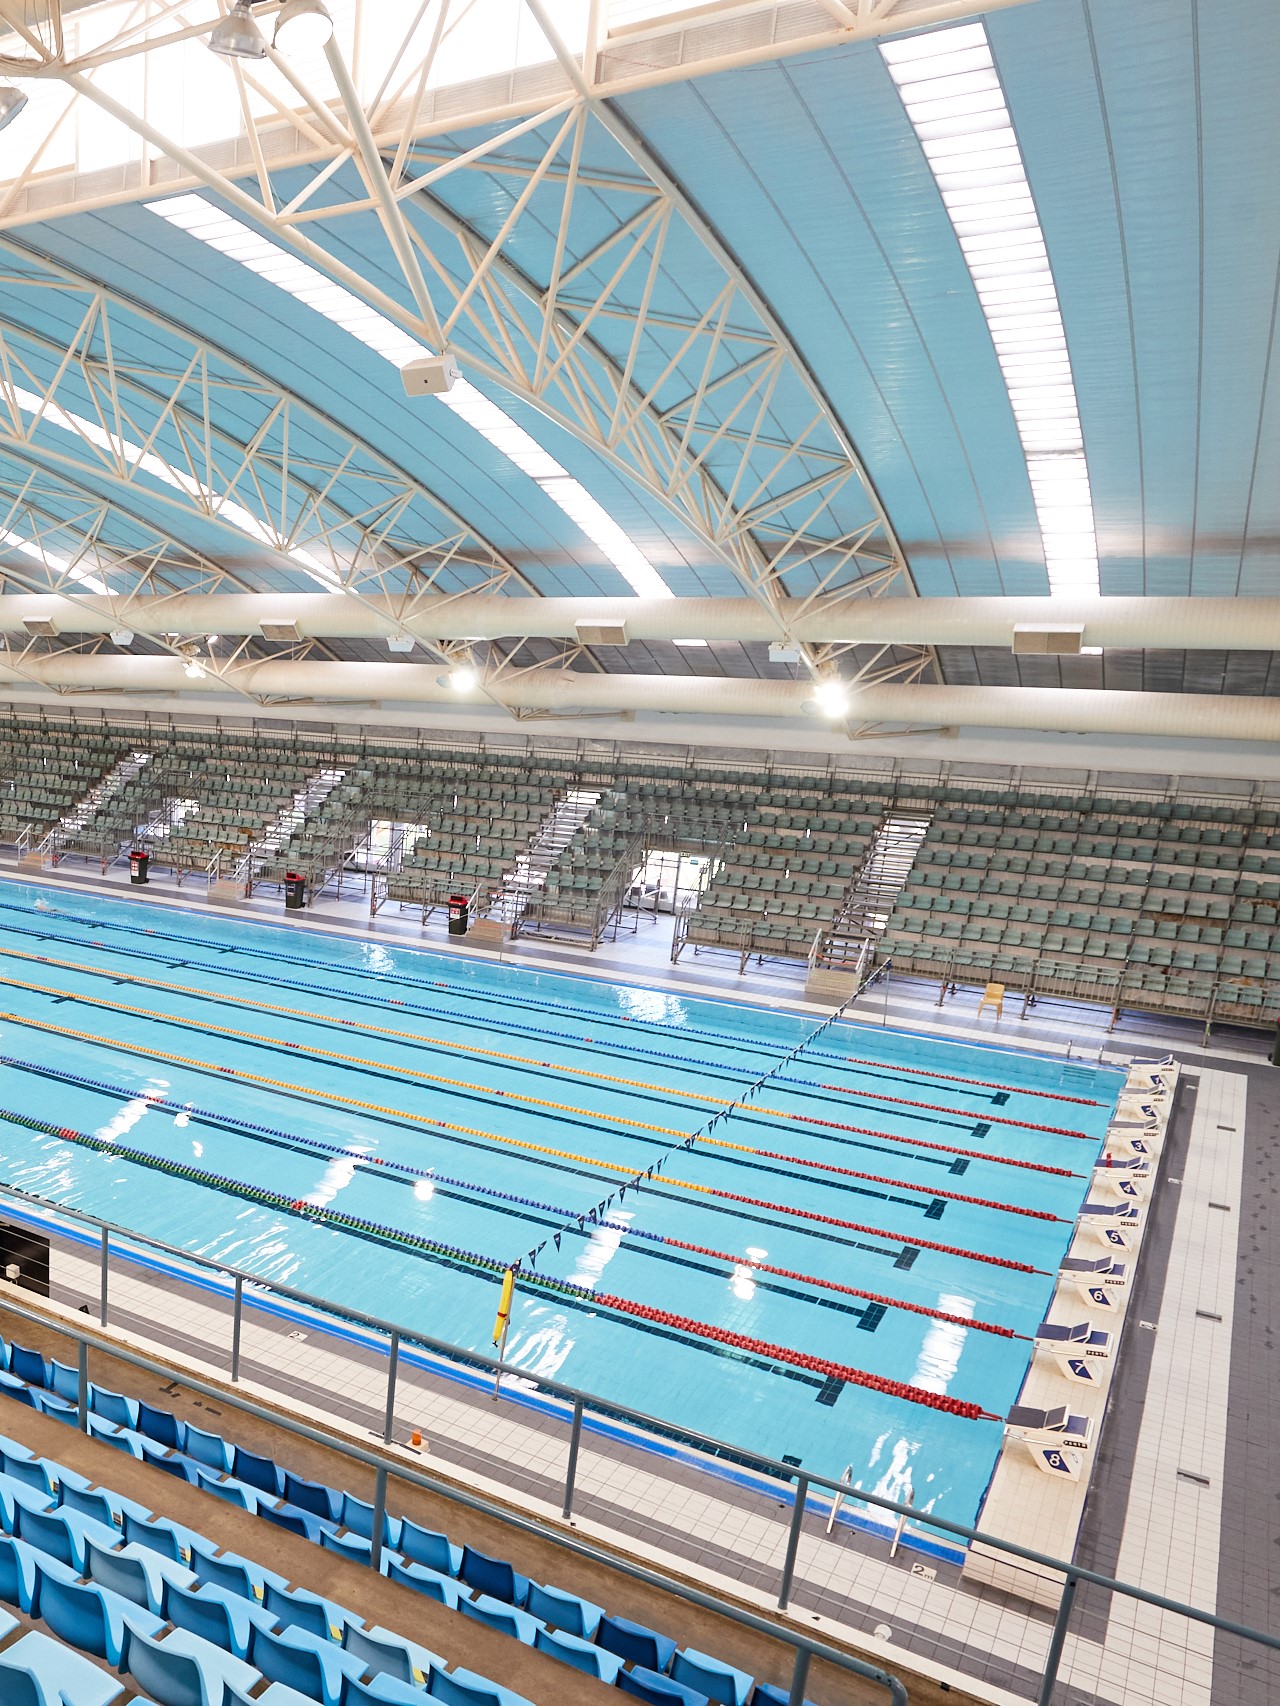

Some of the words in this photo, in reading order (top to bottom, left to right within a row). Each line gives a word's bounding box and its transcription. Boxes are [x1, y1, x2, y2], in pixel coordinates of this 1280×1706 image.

[1145, 1107, 1153, 1116] 2
[1135, 1142, 1142, 1151] 3
[1123, 1184, 1131, 1193] 4
[1110, 1232, 1119, 1242] 5
[1093, 1290, 1103, 1301] 6
[1075, 1362, 1084, 1374] 7
[1049, 1453, 1061, 1467] 8
